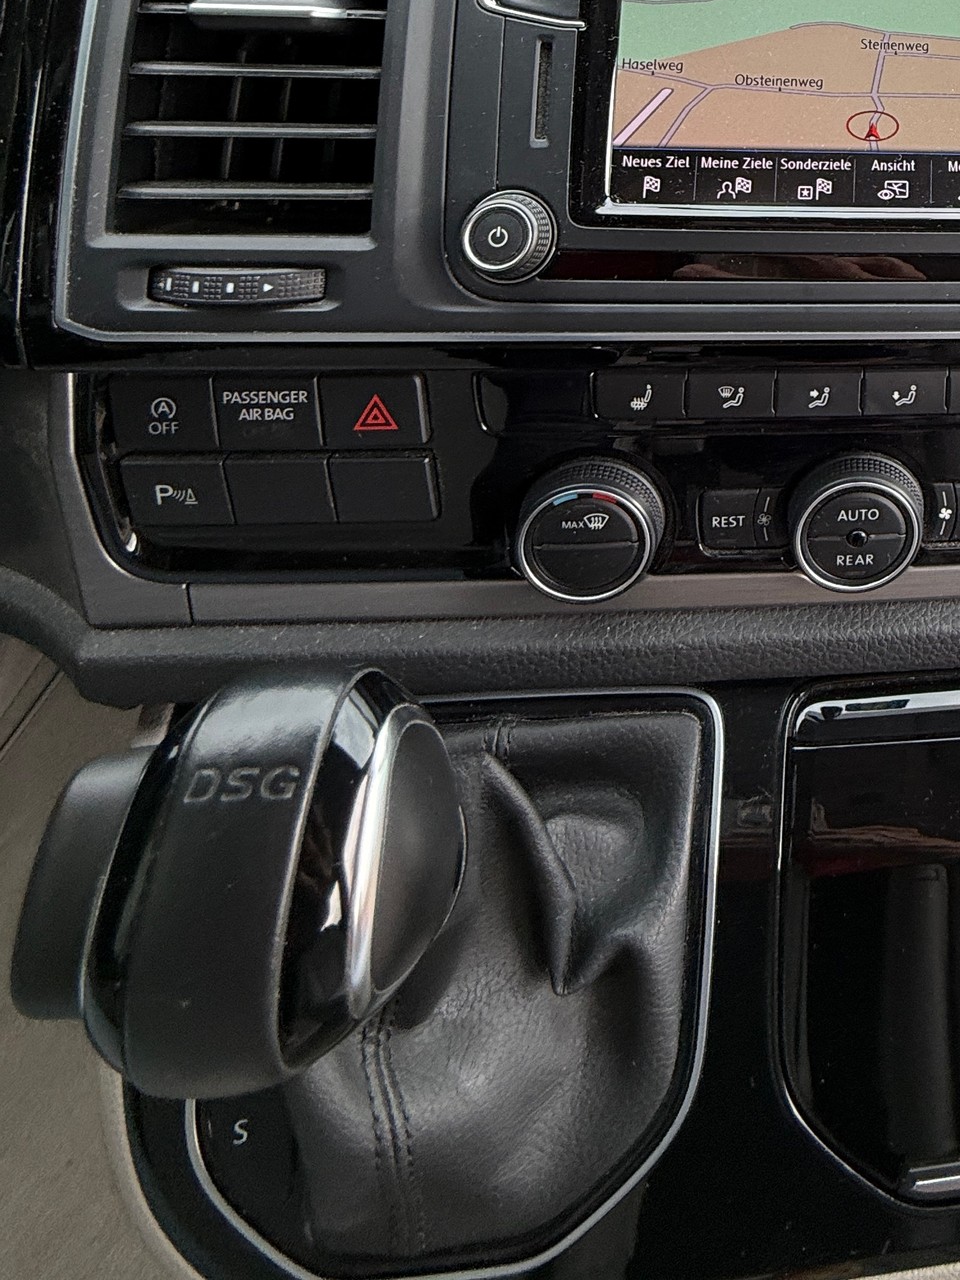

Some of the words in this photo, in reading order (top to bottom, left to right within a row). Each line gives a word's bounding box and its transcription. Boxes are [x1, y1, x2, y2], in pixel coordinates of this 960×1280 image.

[860, 38, 929, 54] Steinenweg
[621, 58, 684, 73] Haselweg
[735, 74, 823, 90] Obsteinenweg
[621, 155, 662, 168] Neues
[665, 155, 690, 168] Ziel
[700, 156, 740, 169] Meine
[742, 157, 774, 170] Ziele
[780, 157, 852, 171] Sonderziele
[871, 158, 916, 171] Ansicht
[223, 390, 308, 404] PASSENGER
[148, 421, 179, 435] OFF
[155, 484, 175, 506] P
[712, 515, 746, 528] REST
[837, 508, 880, 522] AUTO
[561, 518, 586, 529] MAX
[836, 554, 874, 566] REAR
[183, 766, 301, 805] DSG
[233, 1118, 248, 1145] S
